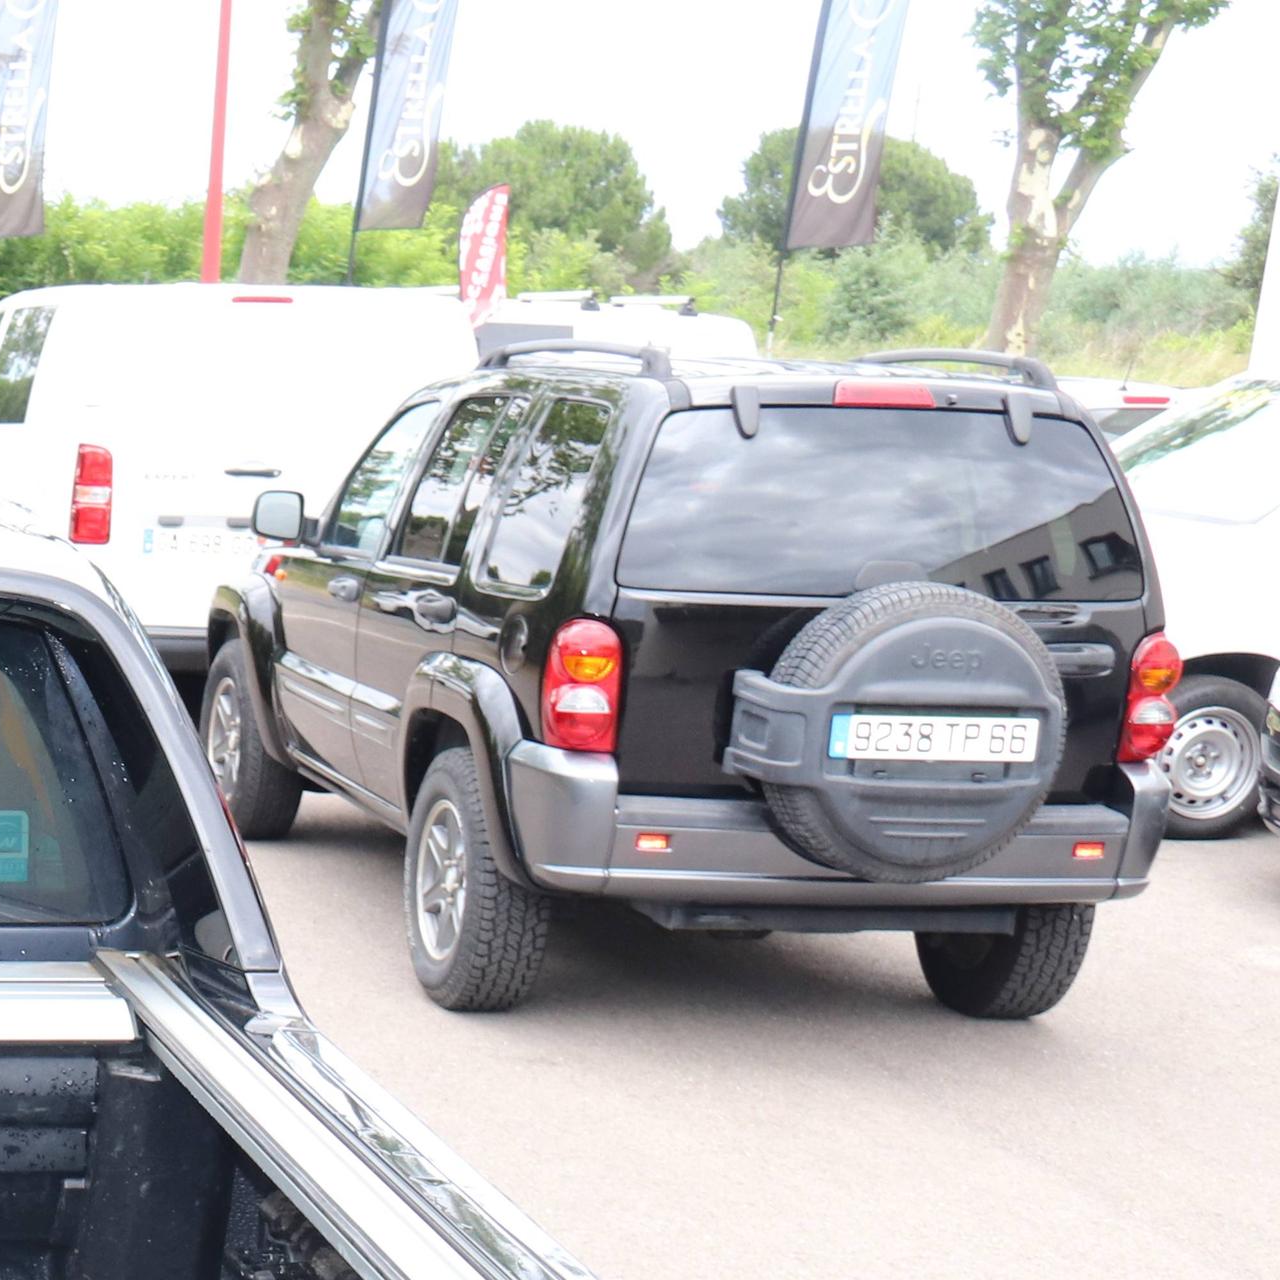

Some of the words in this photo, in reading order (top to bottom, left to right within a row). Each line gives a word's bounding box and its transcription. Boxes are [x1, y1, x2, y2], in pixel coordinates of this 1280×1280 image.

[910, 641, 984, 676] Jeep
[854, 721, 934, 752] 9238
[945, 723, 981, 753] TP
[989, 724, 1028, 754] 66
